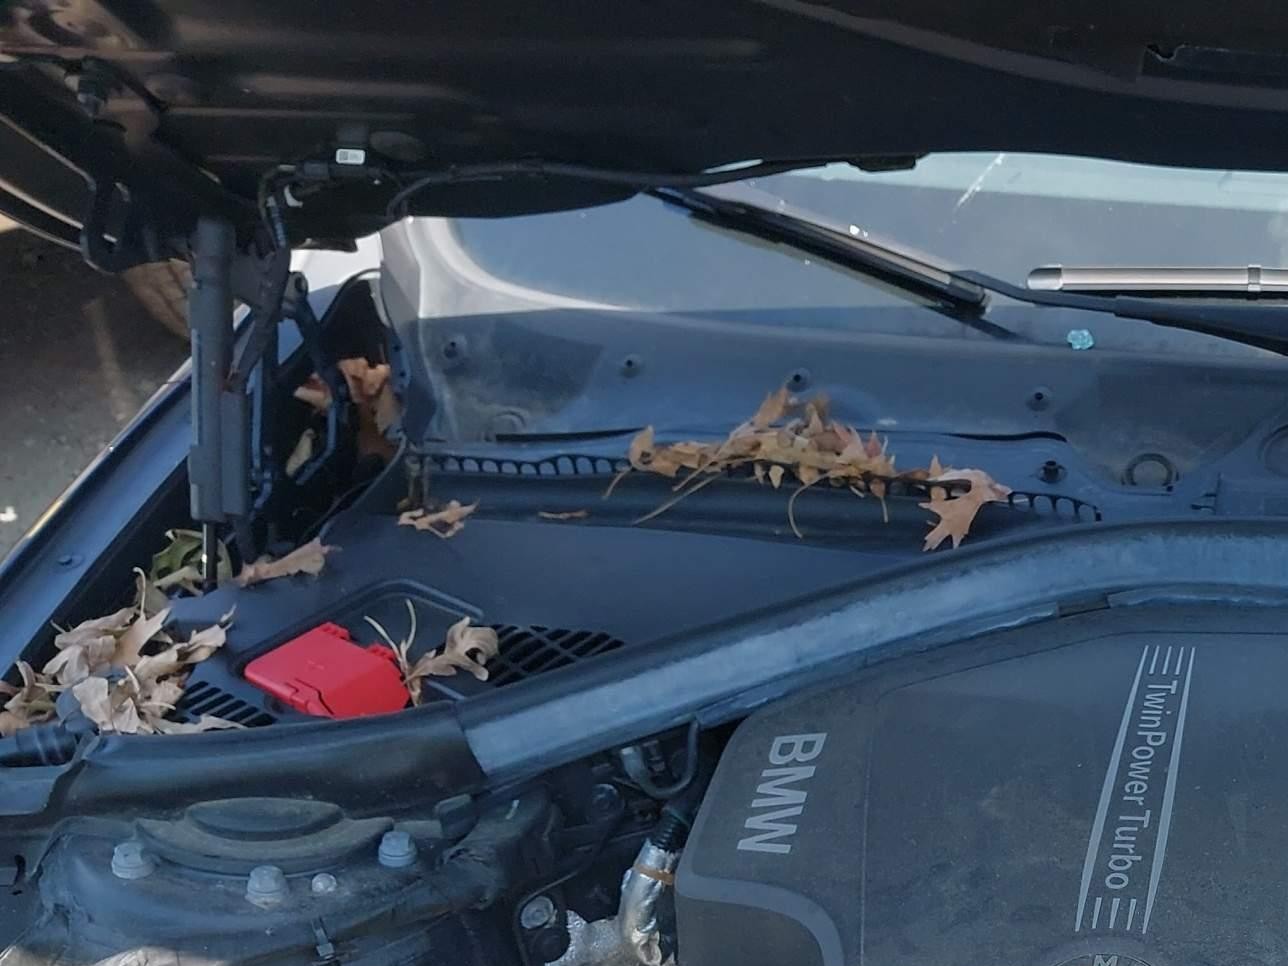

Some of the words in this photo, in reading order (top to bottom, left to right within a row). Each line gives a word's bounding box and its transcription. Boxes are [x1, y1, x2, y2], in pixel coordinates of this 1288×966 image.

[736, 731, 829, 855] BMW
[1121, 679, 1179, 807] TwinPower
[1104, 807, 1151, 891] Turbo
